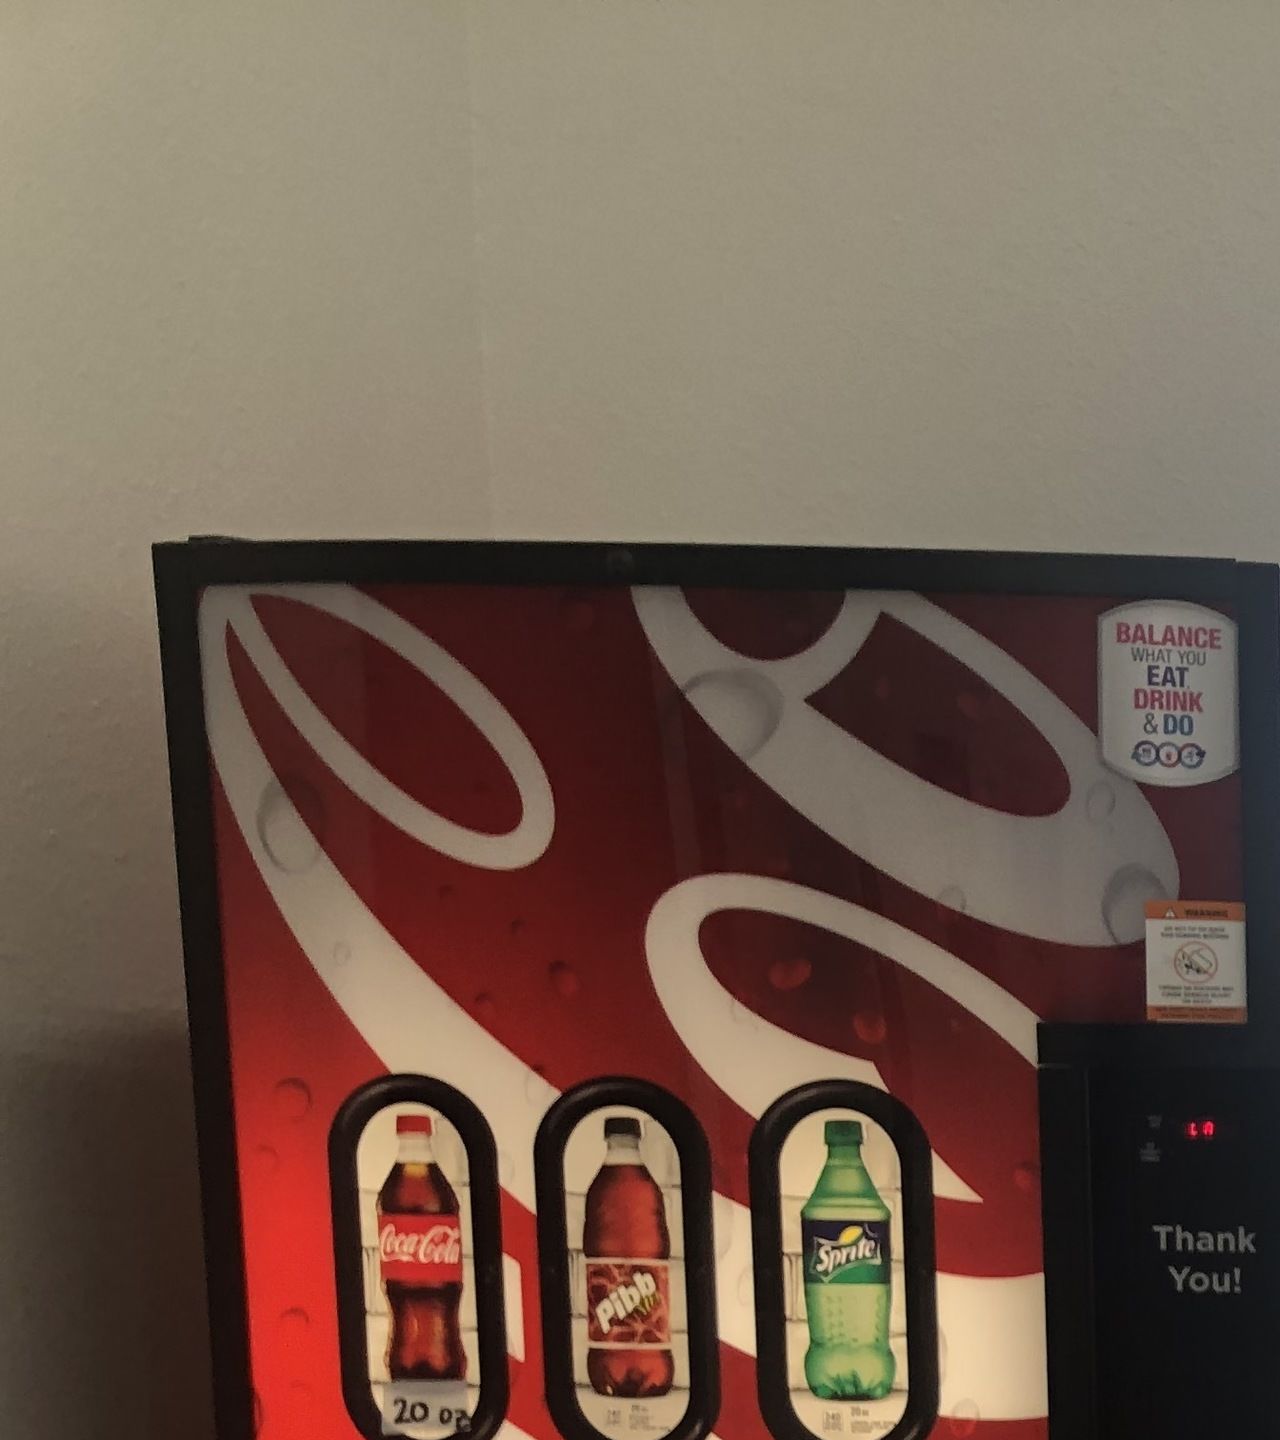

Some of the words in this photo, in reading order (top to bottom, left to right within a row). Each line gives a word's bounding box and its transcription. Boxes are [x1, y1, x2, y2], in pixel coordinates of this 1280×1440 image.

[1116, 621, 1222, 650] BALANCE
[1131, 647, 1173, 665] WHAT
[1177, 649, 1207, 666] YOU
[1133, 688, 1204, 713] DRINK
[1143, 713, 1159, 736] &
[1163, 714, 1194, 736] DO
[1152, 1224, 1256, 1254] Thank
[815, 1238, 878, 1273] Sprite
[1168, 1265, 1242, 1295] You!
[594, 1269, 659, 1335] Pibb
[393, 1397, 430, 1426] 20
